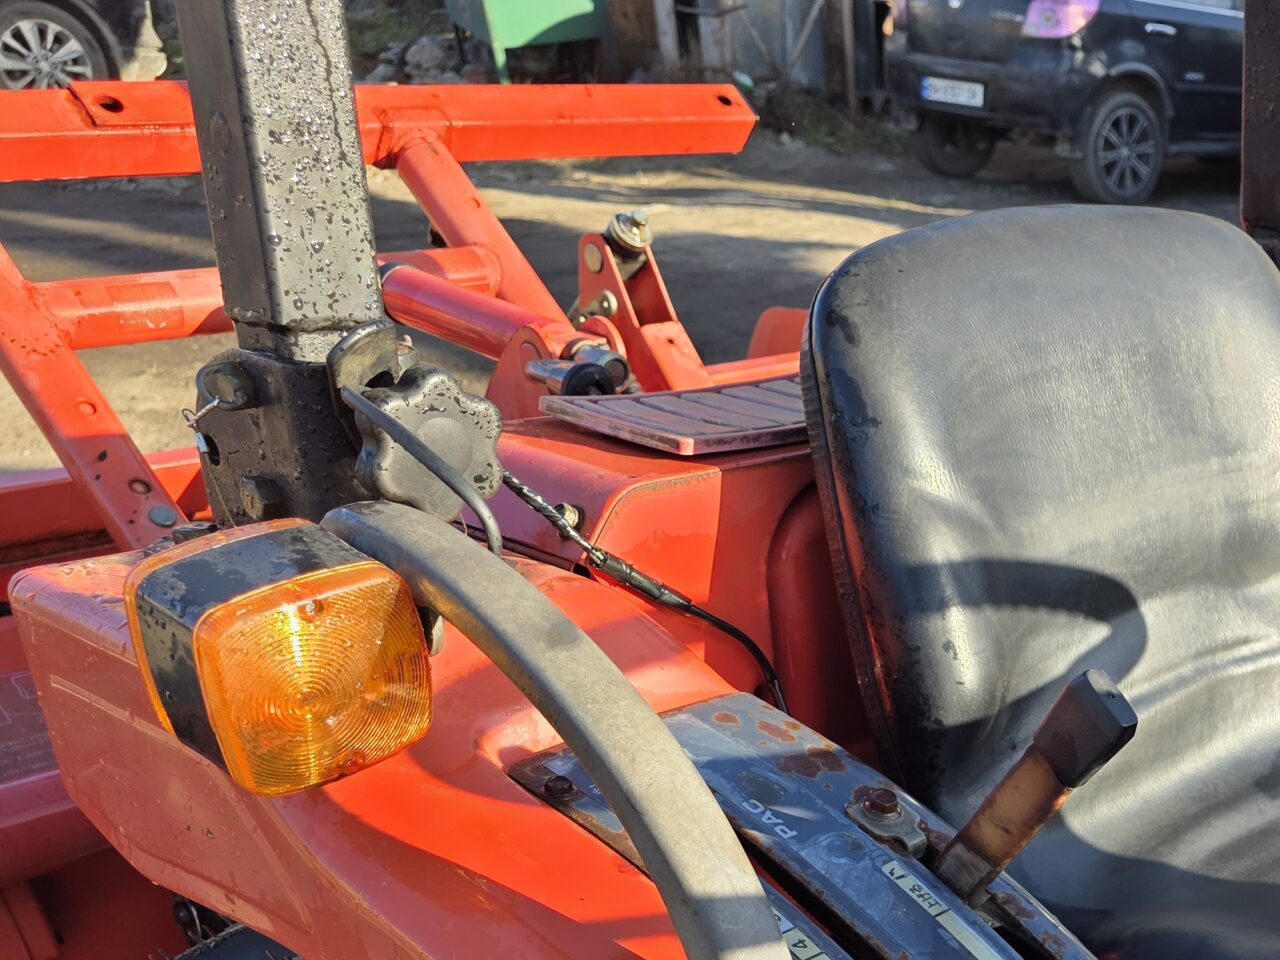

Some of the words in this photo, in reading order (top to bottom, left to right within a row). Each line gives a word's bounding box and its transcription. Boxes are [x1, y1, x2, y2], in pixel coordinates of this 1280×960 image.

[742, 799, 799, 839] PAC
[909, 884, 943, 909] 上げる
[791, 938, 808, 949] 4
